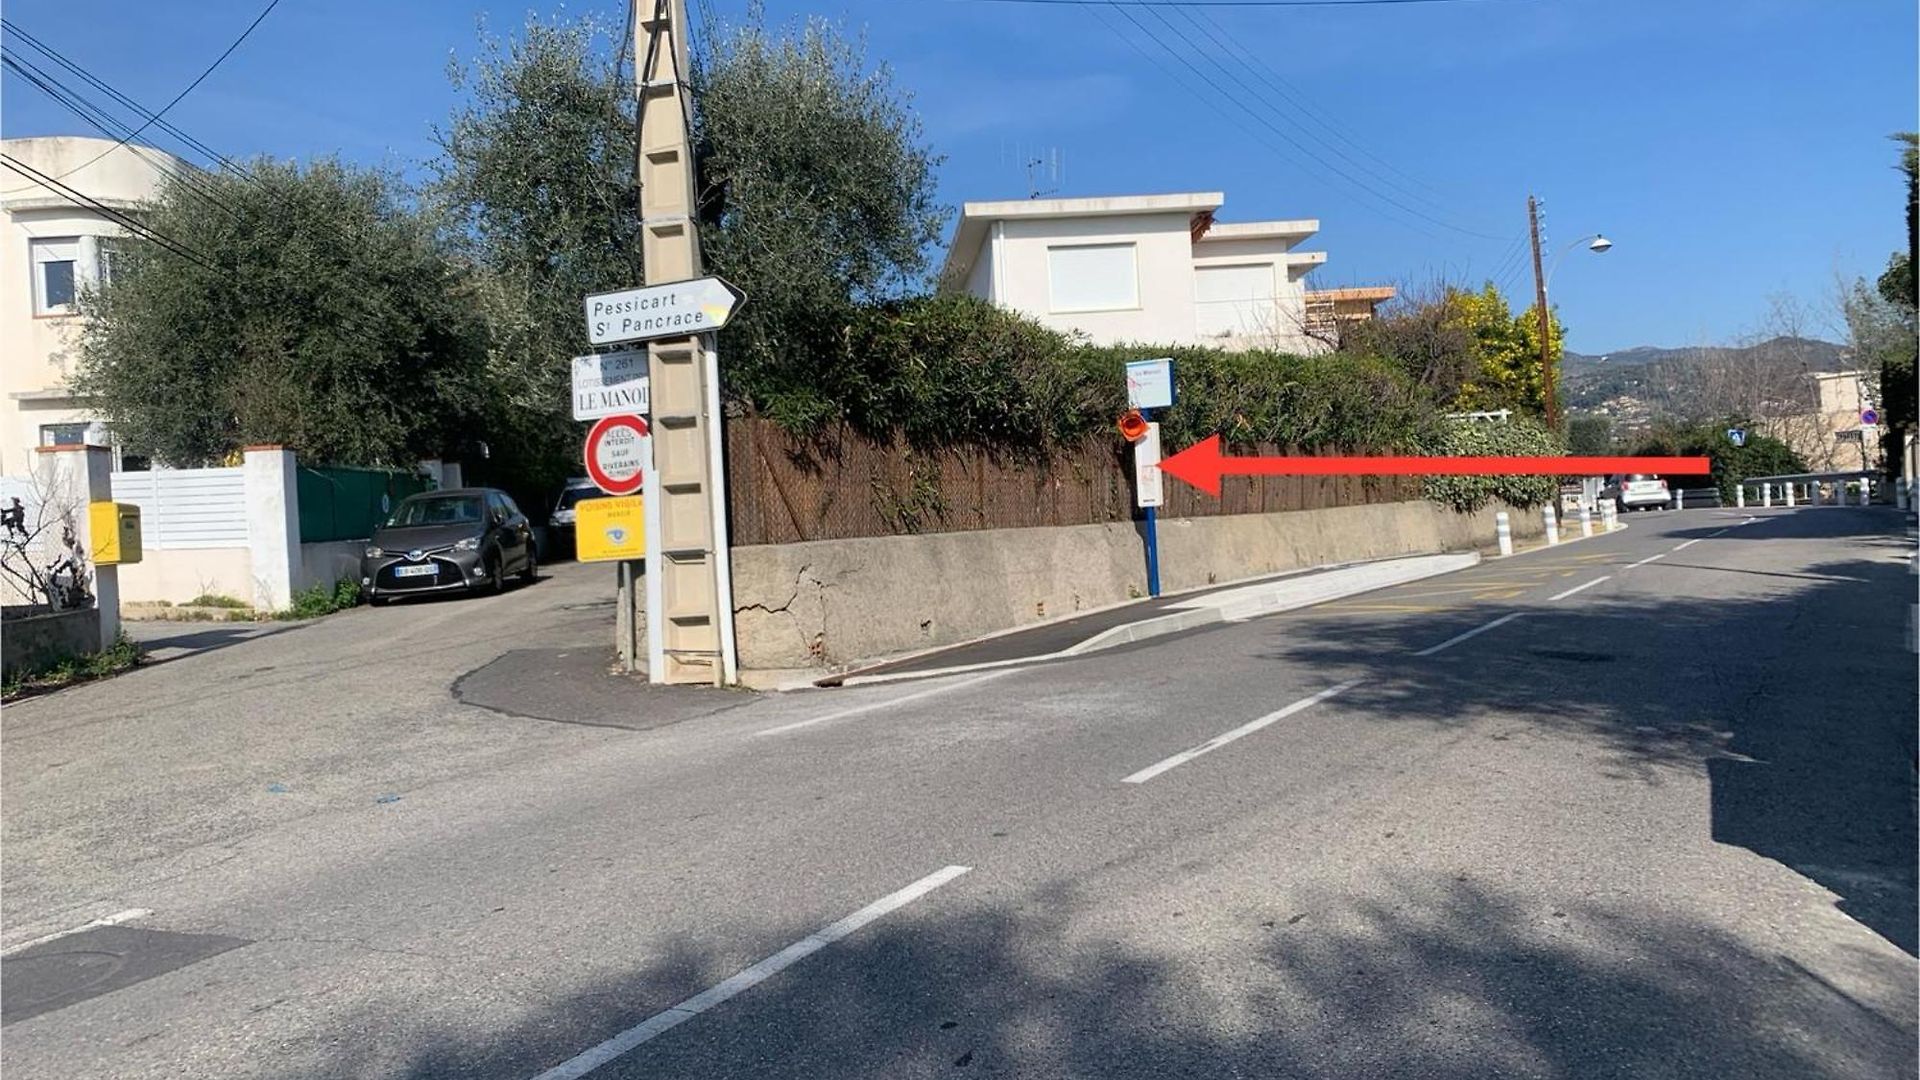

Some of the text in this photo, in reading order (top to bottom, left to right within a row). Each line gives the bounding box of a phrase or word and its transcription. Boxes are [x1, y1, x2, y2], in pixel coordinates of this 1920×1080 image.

[594, 293, 676, 317] Pessicart
[622, 312, 704, 333] Pancrace
[615, 358, 634, 370] 261
[580, 393, 597, 410] LE
[612, 448, 628, 457] SAUF
